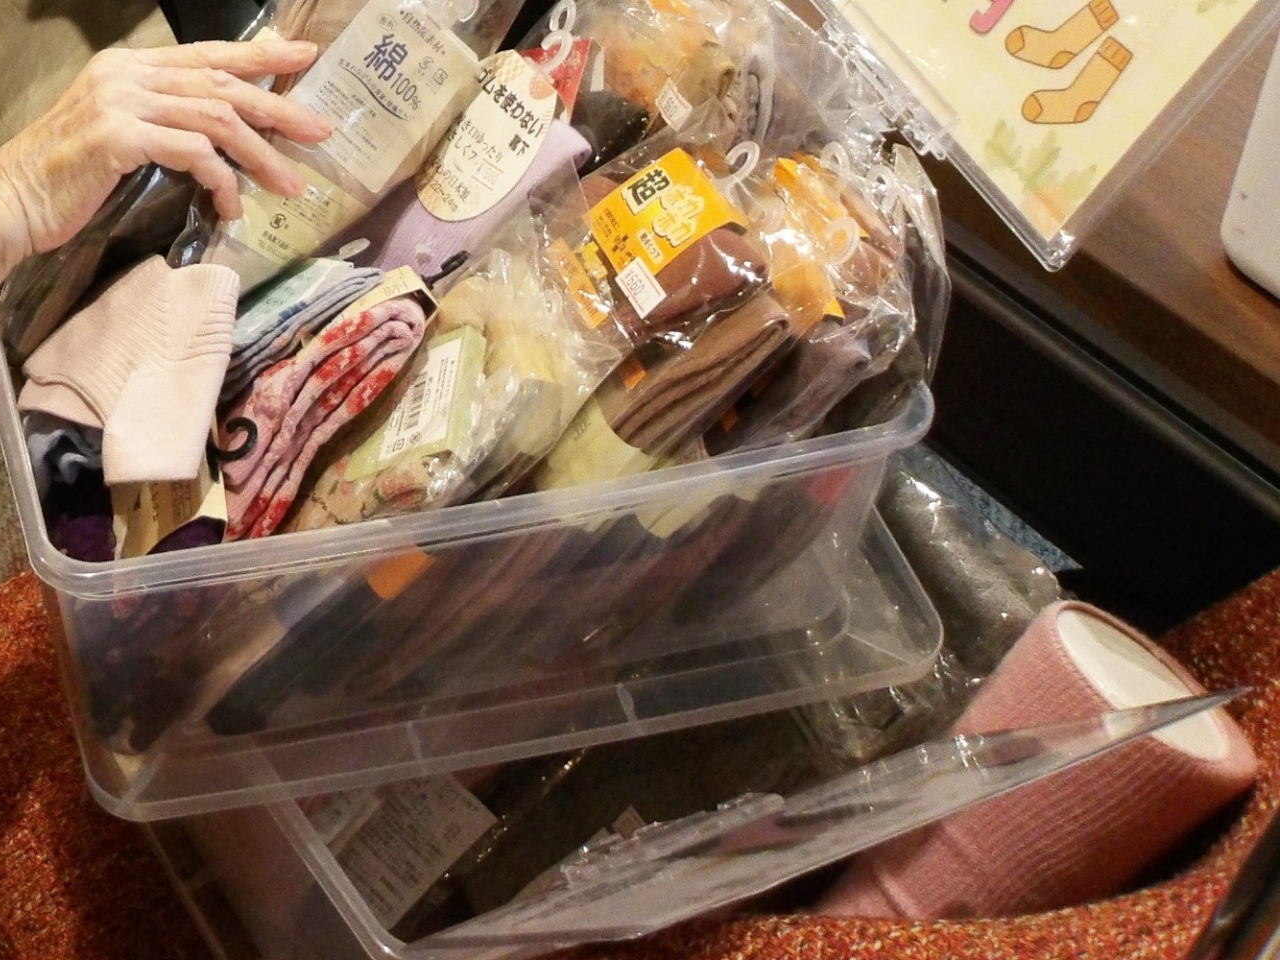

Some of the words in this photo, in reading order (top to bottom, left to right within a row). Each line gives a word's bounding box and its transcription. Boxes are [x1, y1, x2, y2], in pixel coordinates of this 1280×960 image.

[475, 68, 545, 139] ゴムを使わない
[627, 168, 670, 207] 超
[624, 269, 646, 296] ¥660
